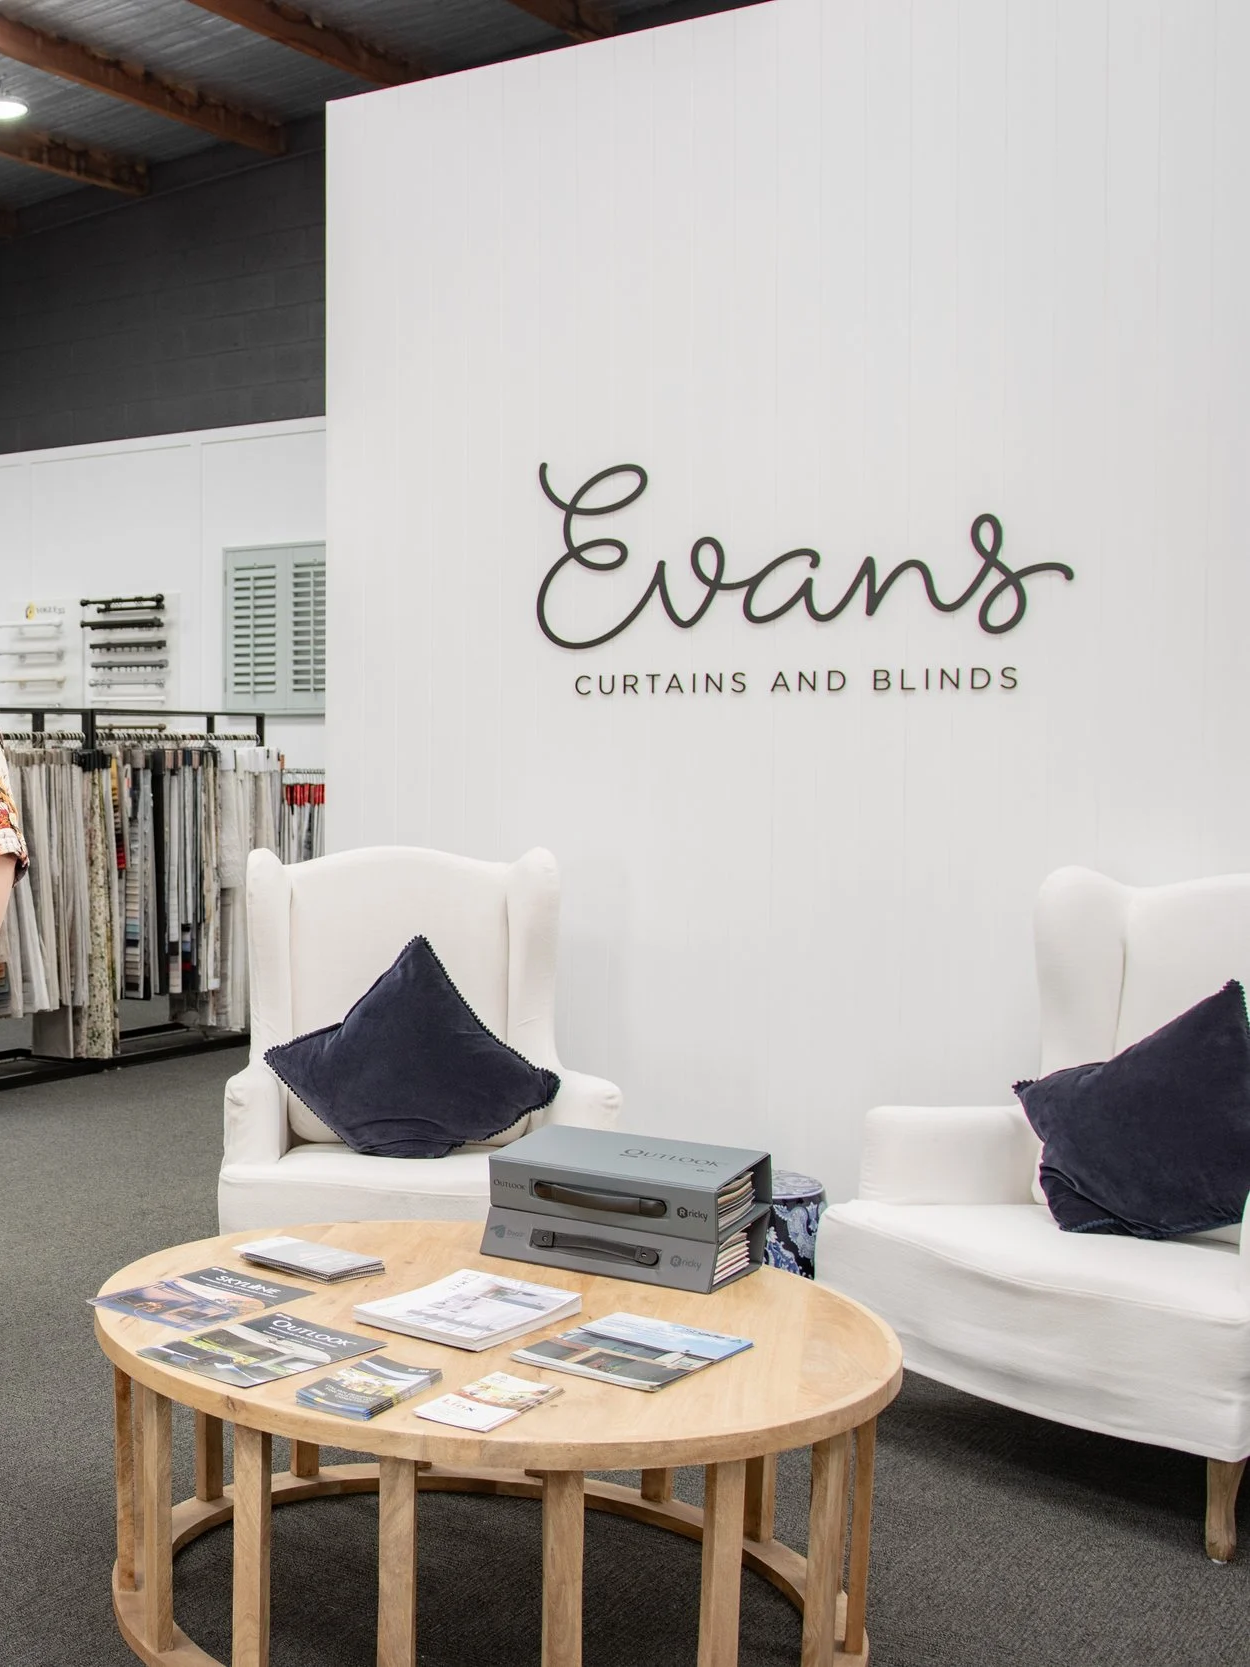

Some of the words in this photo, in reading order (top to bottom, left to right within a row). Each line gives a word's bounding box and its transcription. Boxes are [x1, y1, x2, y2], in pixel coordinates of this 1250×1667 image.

[536, 461, 1075, 650] Evans
[574, 671, 747, 696] CURTAINS
[770, 669, 848, 693] AND
[873, 666, 1019, 691] BLINDS
[688, 1209, 709, 1223] ricky
[682, 1259, 702, 1271] ricky
[272, 1318, 351, 1347] OUTLOOK
